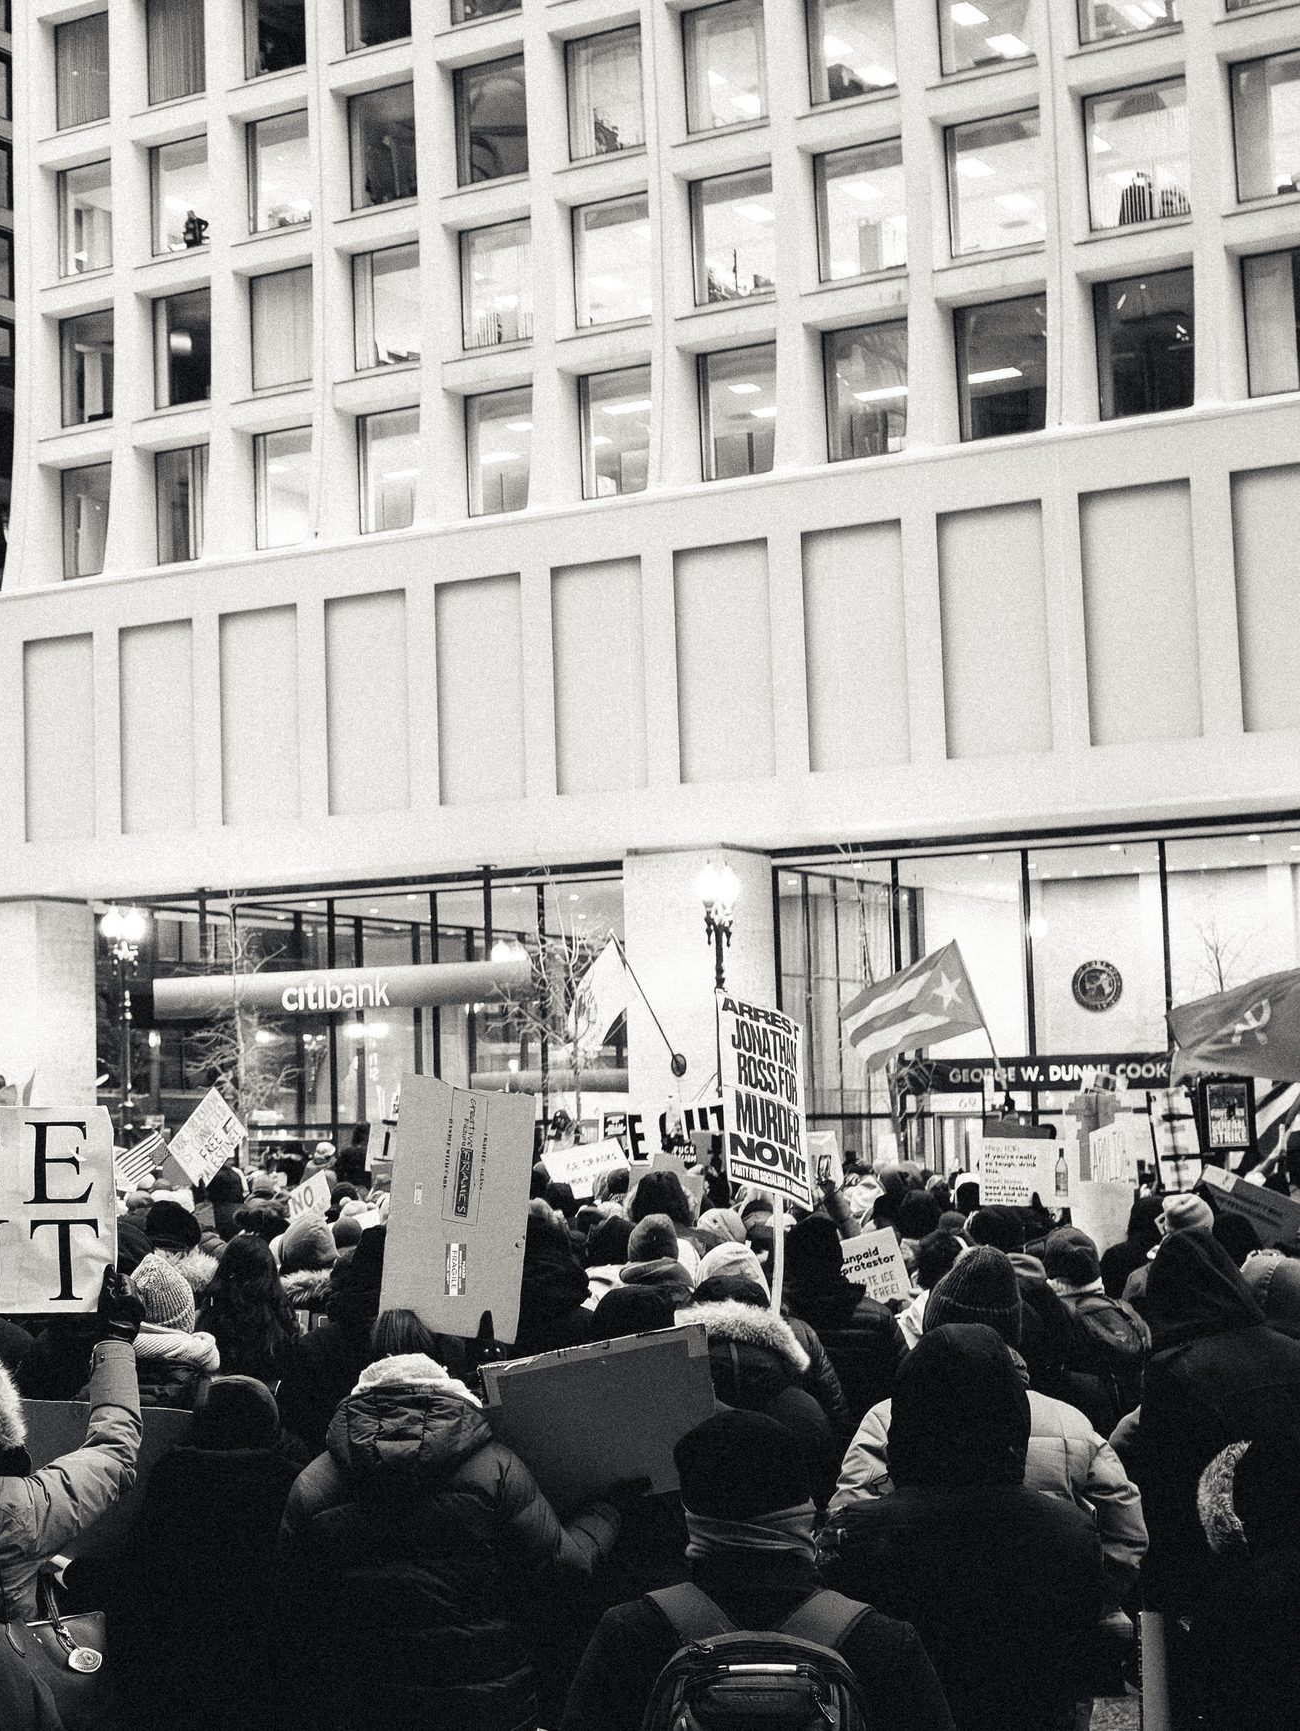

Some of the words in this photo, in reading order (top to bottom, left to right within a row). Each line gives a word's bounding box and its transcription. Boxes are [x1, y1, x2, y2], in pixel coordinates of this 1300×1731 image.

[281, 978, 390, 1012] citibank
[722, 997, 799, 1039] ARREST
[731, 1018, 798, 1073] JONATHAN
[736, 1051, 777, 1095] ROSS
[777, 1065, 798, 1106] FOR
[1020, 1065, 1045, 1082] W.
[1116, 1062, 1168, 1079] COOK
[735, 1089, 802, 1156] MURDER
[198, 1132, 223, 1160] FREE
[729, 1132, 807, 1183] NOW!
[1015, 1153, 1037, 1161] really
[457, 1151, 471, 1213] FRAMES
[292, 1186, 313, 1215] NO
[841, 1254, 895, 1276] protestor
[842, 1246, 879, 1265] unpaid
[881, 1270, 895, 1283] ICE
